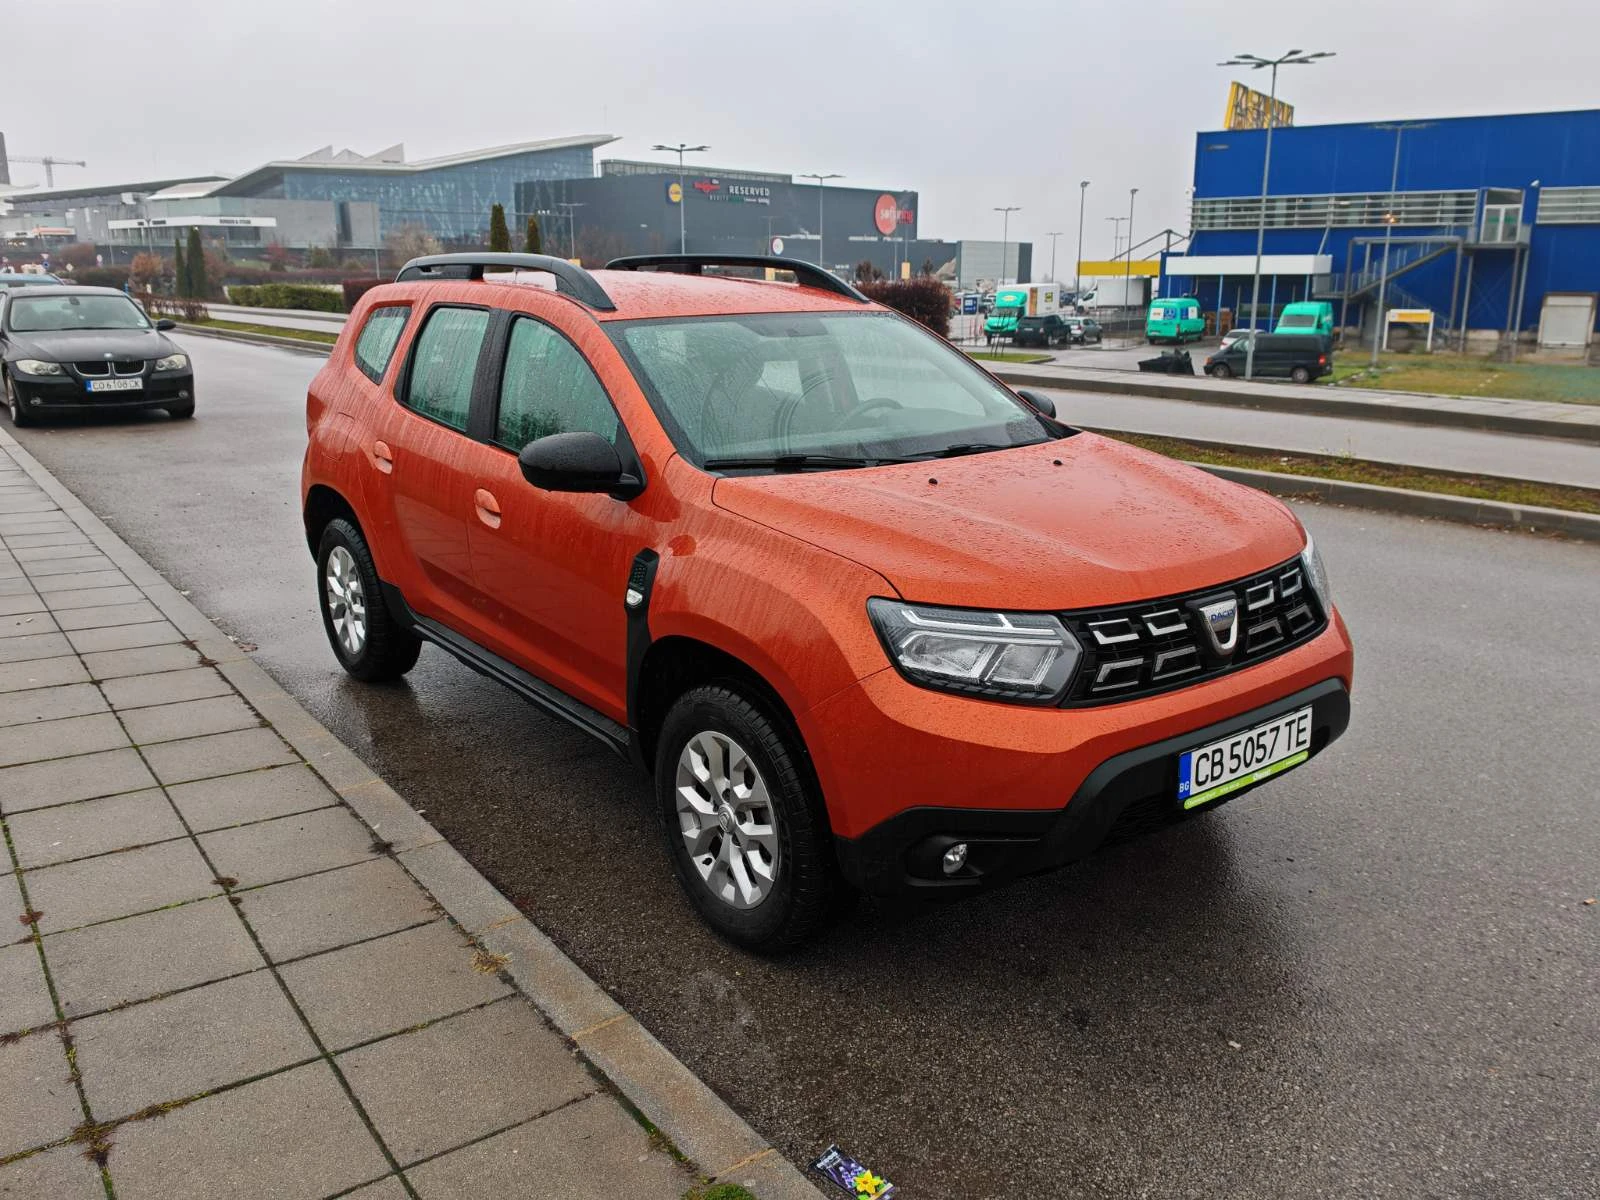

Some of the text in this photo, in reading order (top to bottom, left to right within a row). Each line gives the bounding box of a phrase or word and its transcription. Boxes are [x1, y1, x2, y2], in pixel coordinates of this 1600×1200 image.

[729, 185, 770, 197] RESERVED
[1195, 714, 1308, 787] CB 5057 TE
[1179, 781, 1190, 793] BG
